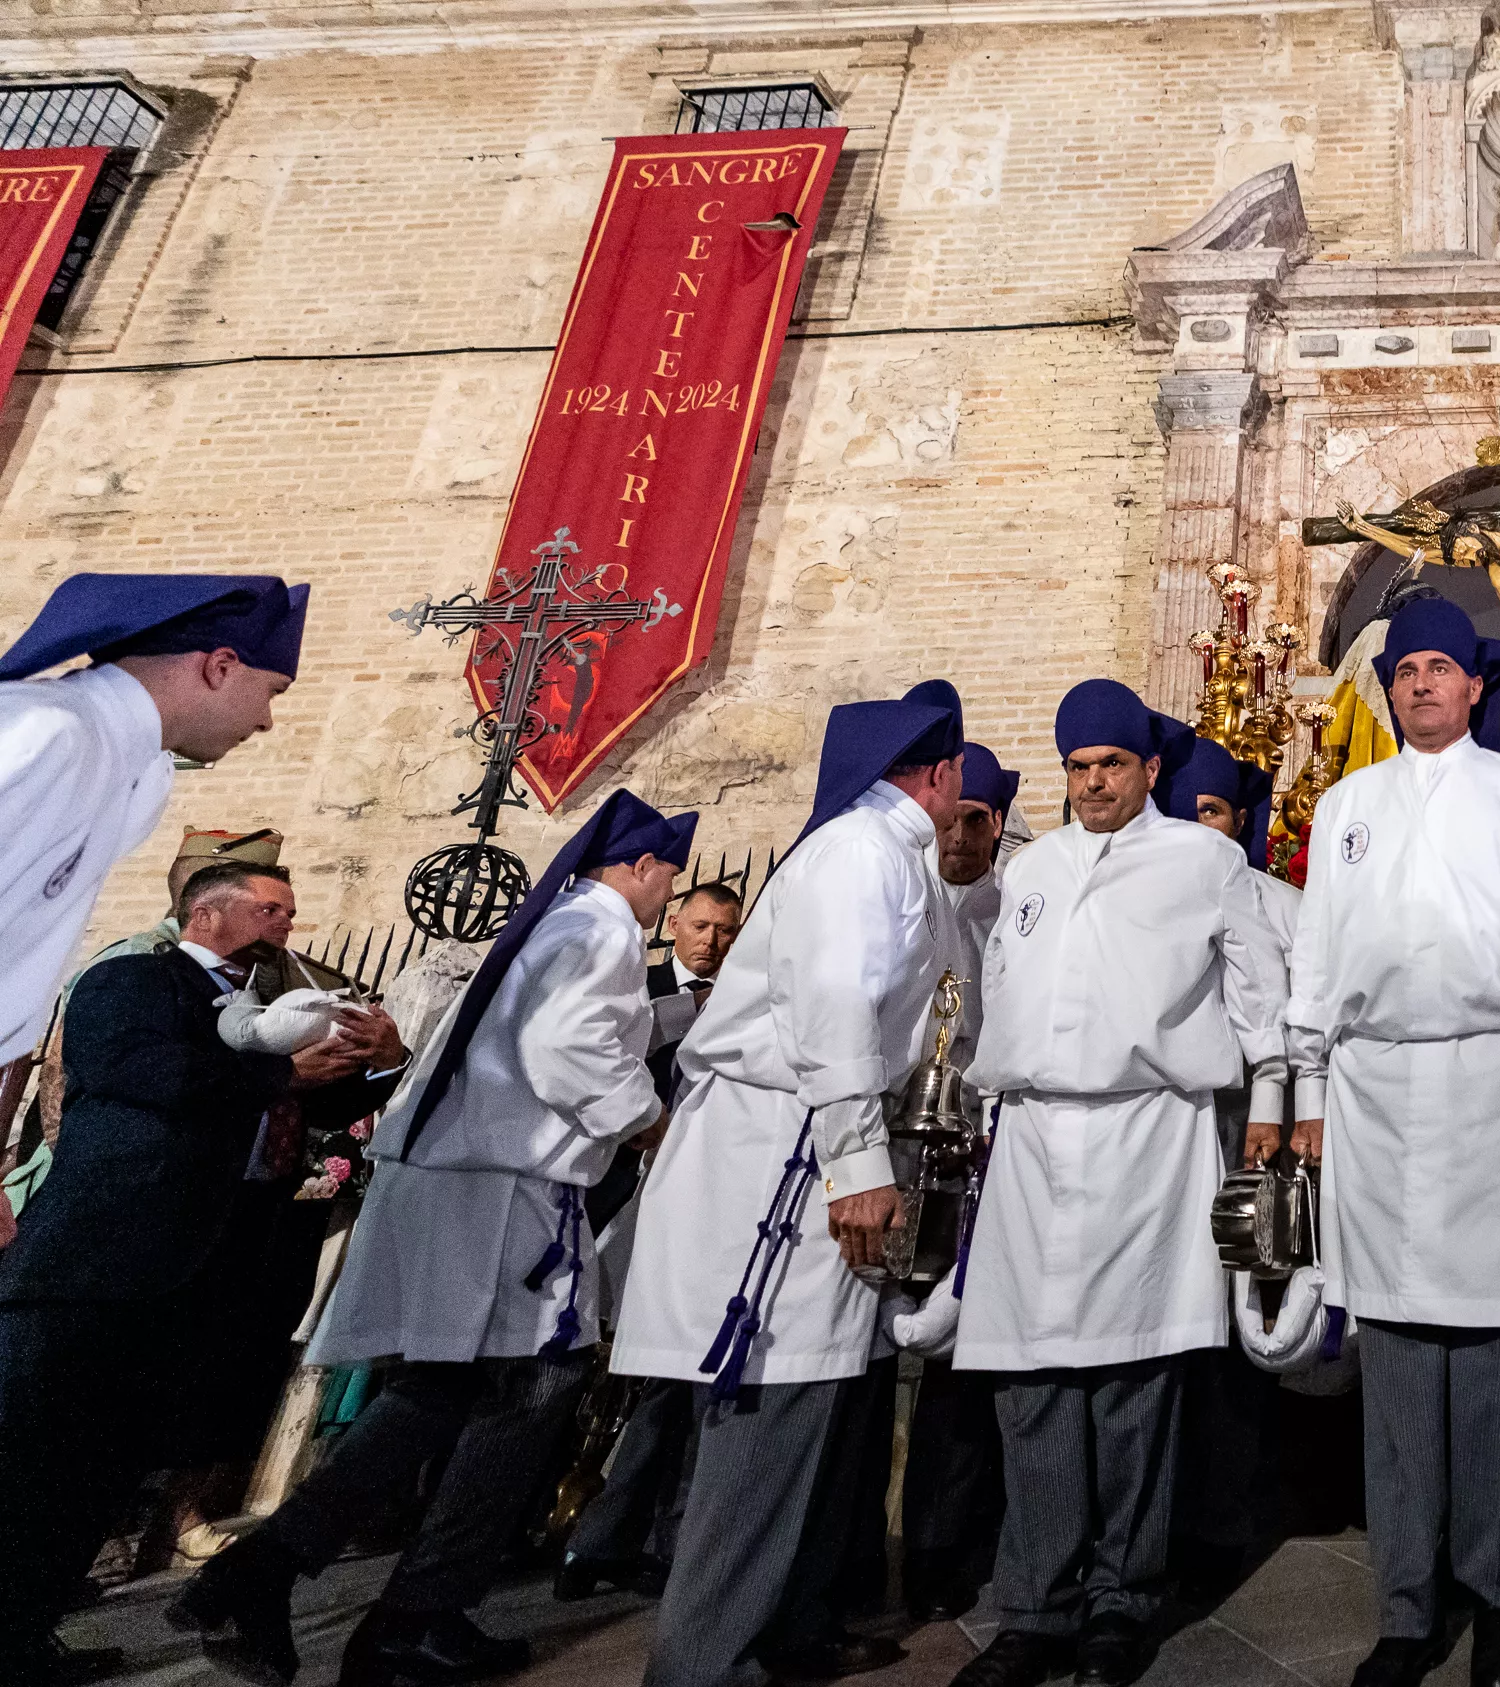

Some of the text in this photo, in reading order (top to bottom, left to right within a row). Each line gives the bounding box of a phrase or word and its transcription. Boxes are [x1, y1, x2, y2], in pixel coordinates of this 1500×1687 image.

[0, 176, 59, 203] RE
[633, 152, 802, 190] SANGRE
[558, 379, 741, 417] 1924 2024
[594, 200, 725, 593] CENTENARIO
